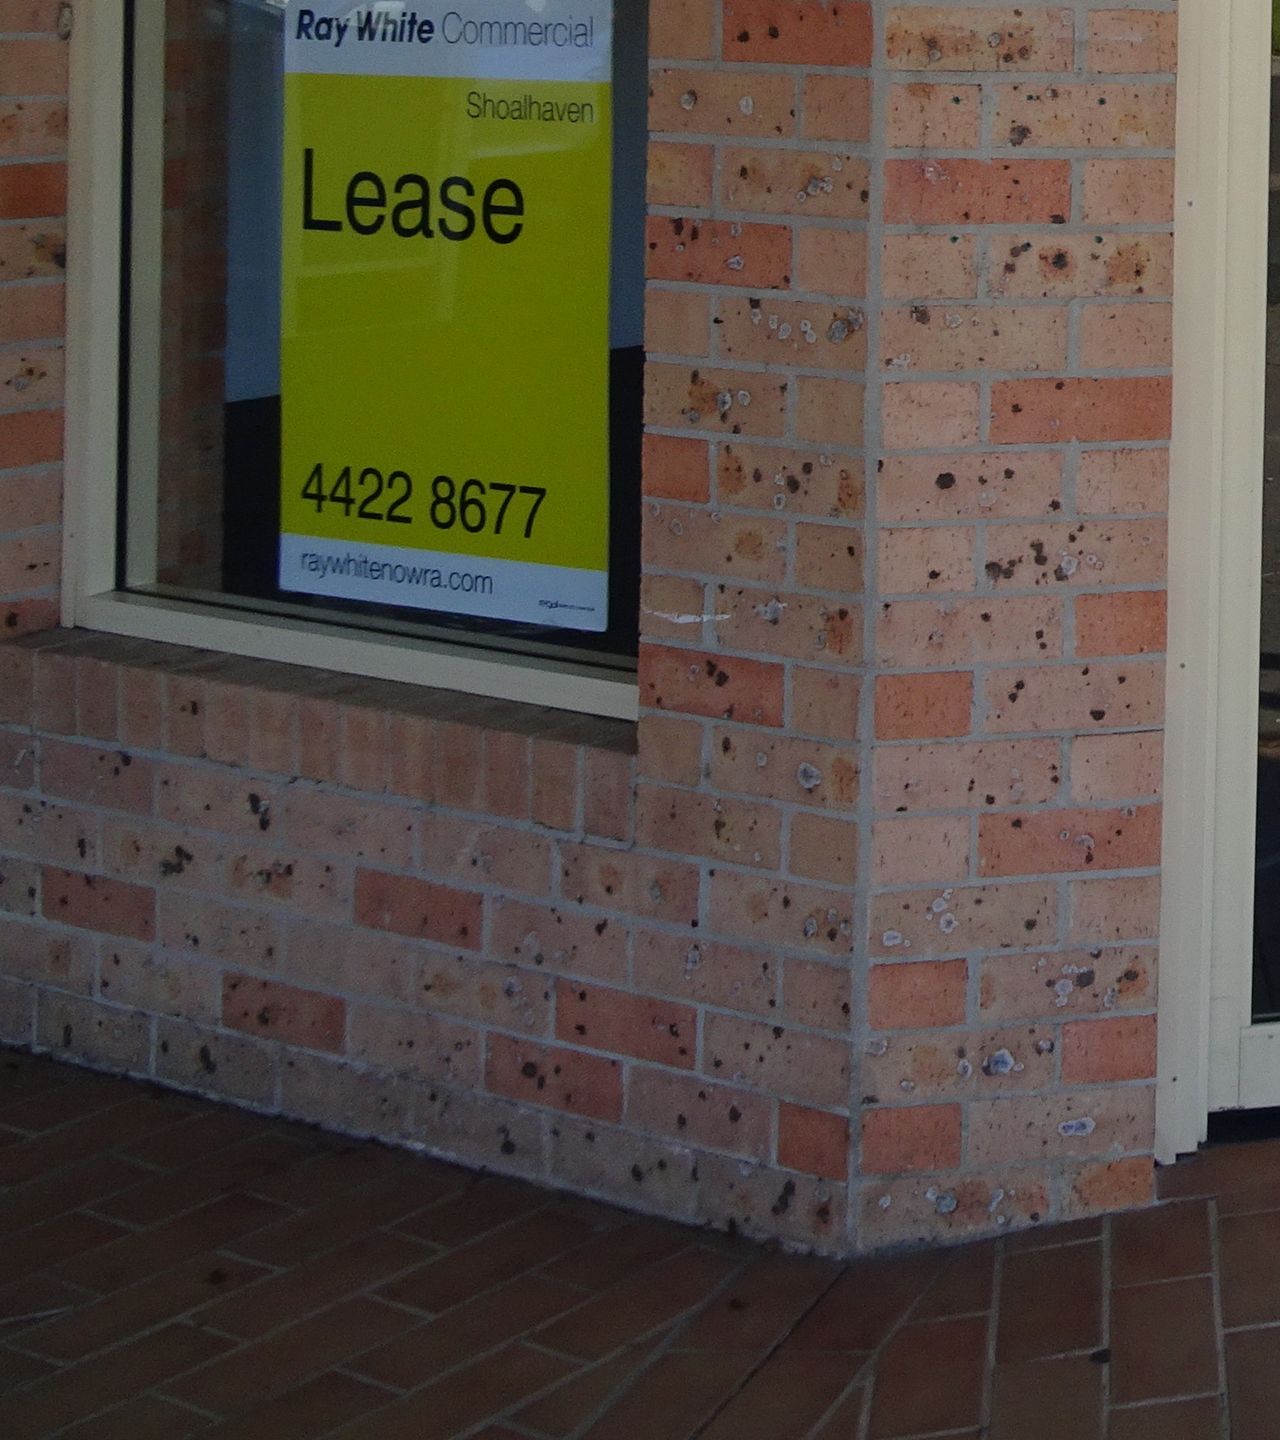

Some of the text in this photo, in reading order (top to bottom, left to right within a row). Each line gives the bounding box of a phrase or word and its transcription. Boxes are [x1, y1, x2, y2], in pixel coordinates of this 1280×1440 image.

[295, 9, 594, 48] Ray White Commercial
[466, 90, 595, 123] Shoalhaven
[301, 147, 525, 245] Lease
[301, 462, 547, 539] 4422 8677
[300, 551, 494, 595] raywhitenowra.com
